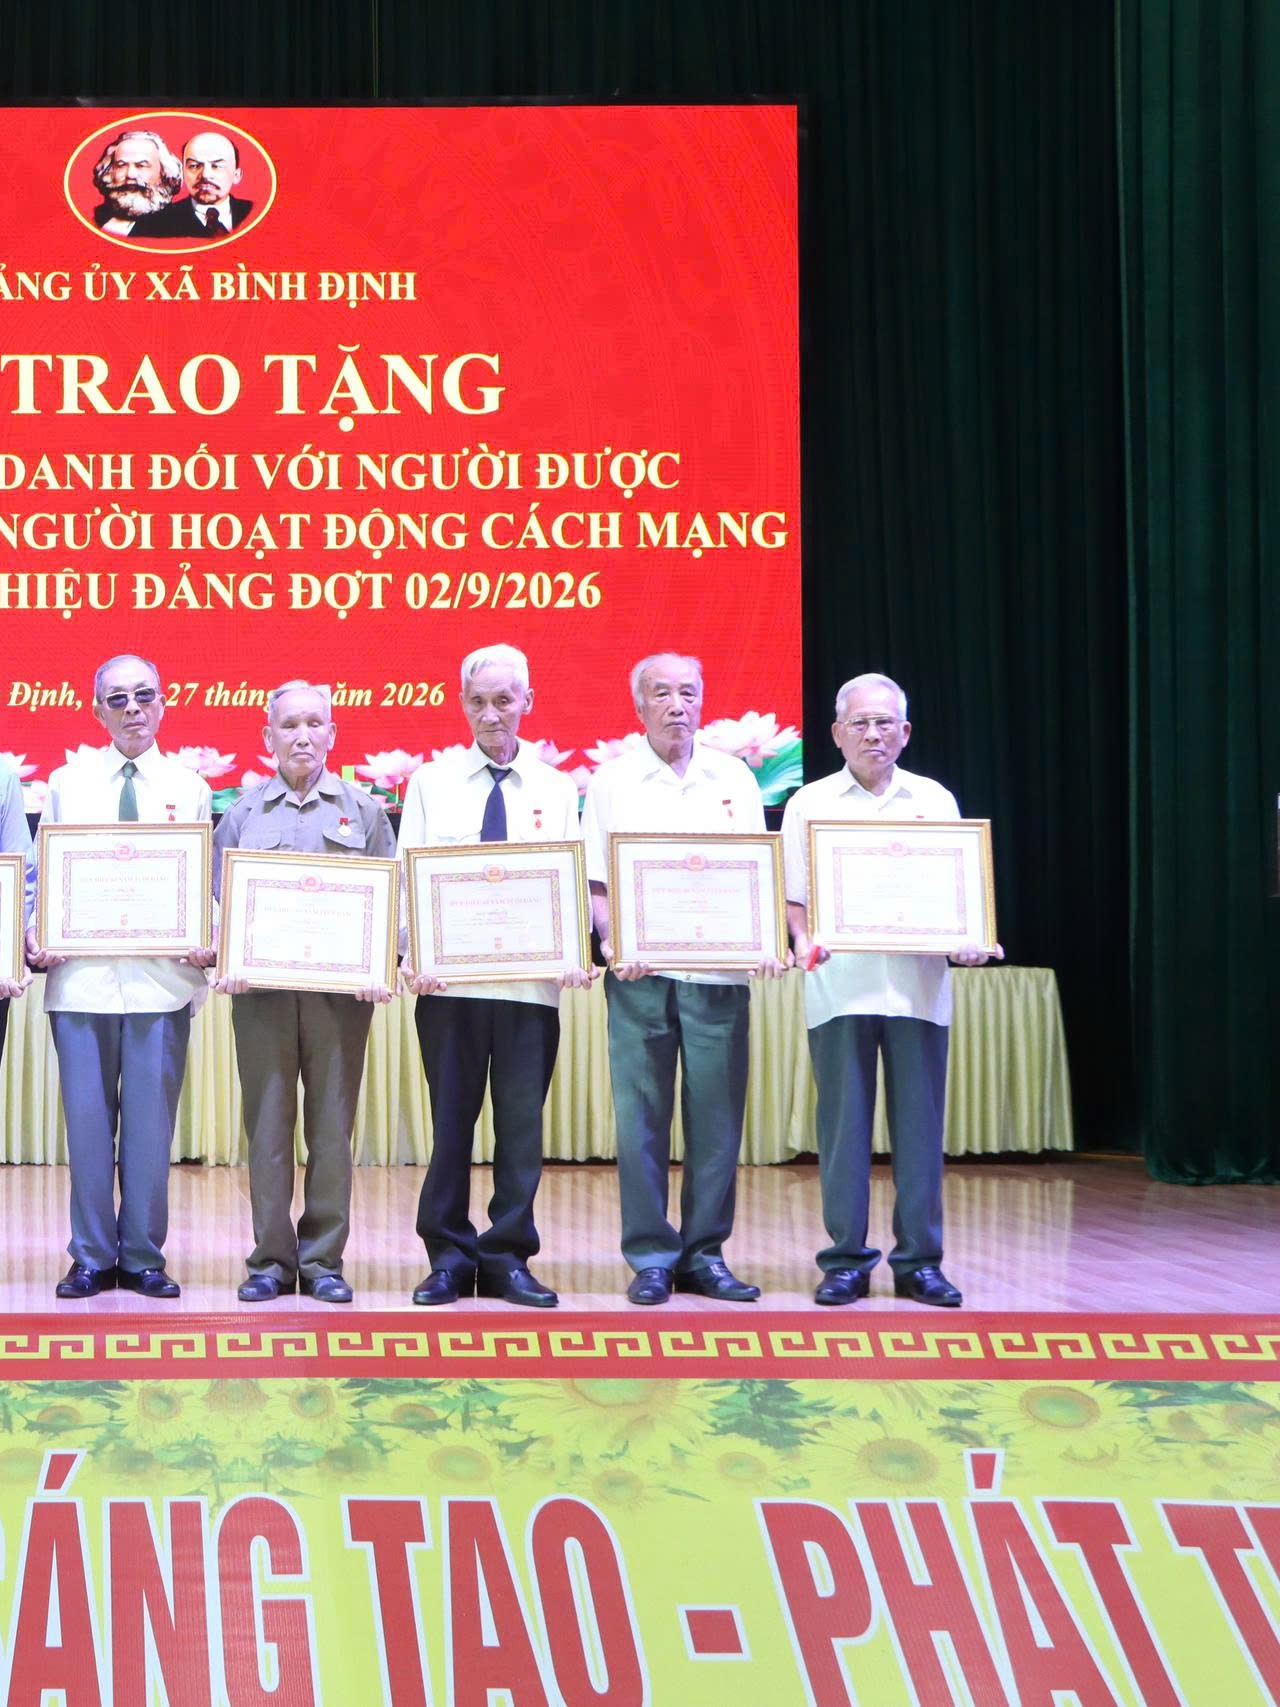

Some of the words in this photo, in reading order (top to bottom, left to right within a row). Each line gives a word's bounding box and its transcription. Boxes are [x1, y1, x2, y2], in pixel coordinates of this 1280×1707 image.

[83, 263, 136, 301] ỦY
[146, 264, 200, 301] XÃ
[212, 263, 307, 301] BÌNH
[318, 271, 417, 309] ĐỊNH
[1, 354, 241, 415] TRAO
[264, 343, 506, 432] TẶNG
[148, 443, 238, 490] ĐỐI
[252, 443, 342, 490] VỚI
[356, 443, 523, 490] NGƯỜI
[535, 447, 681, 498] ĐƯỢC
[168, 512, 311, 560] HOẠT
[322, 508, 469, 560] ĐỘNG
[482, 502, 624, 549] CÁCH
[637, 511, 789, 559] MẠNG
[131, 562, 276, 609] ĐẢNG
[288, 570, 393, 619] ĐỢT
[405, 571, 602, 610] 02/9/2026
[7, 681, 83, 712] Định,
[165, 682, 200, 706] 27
[331, 681, 372, 706] ăm
[380, 682, 446, 706] 2026
[756, 1448, 1186, 1707] PHÁT
